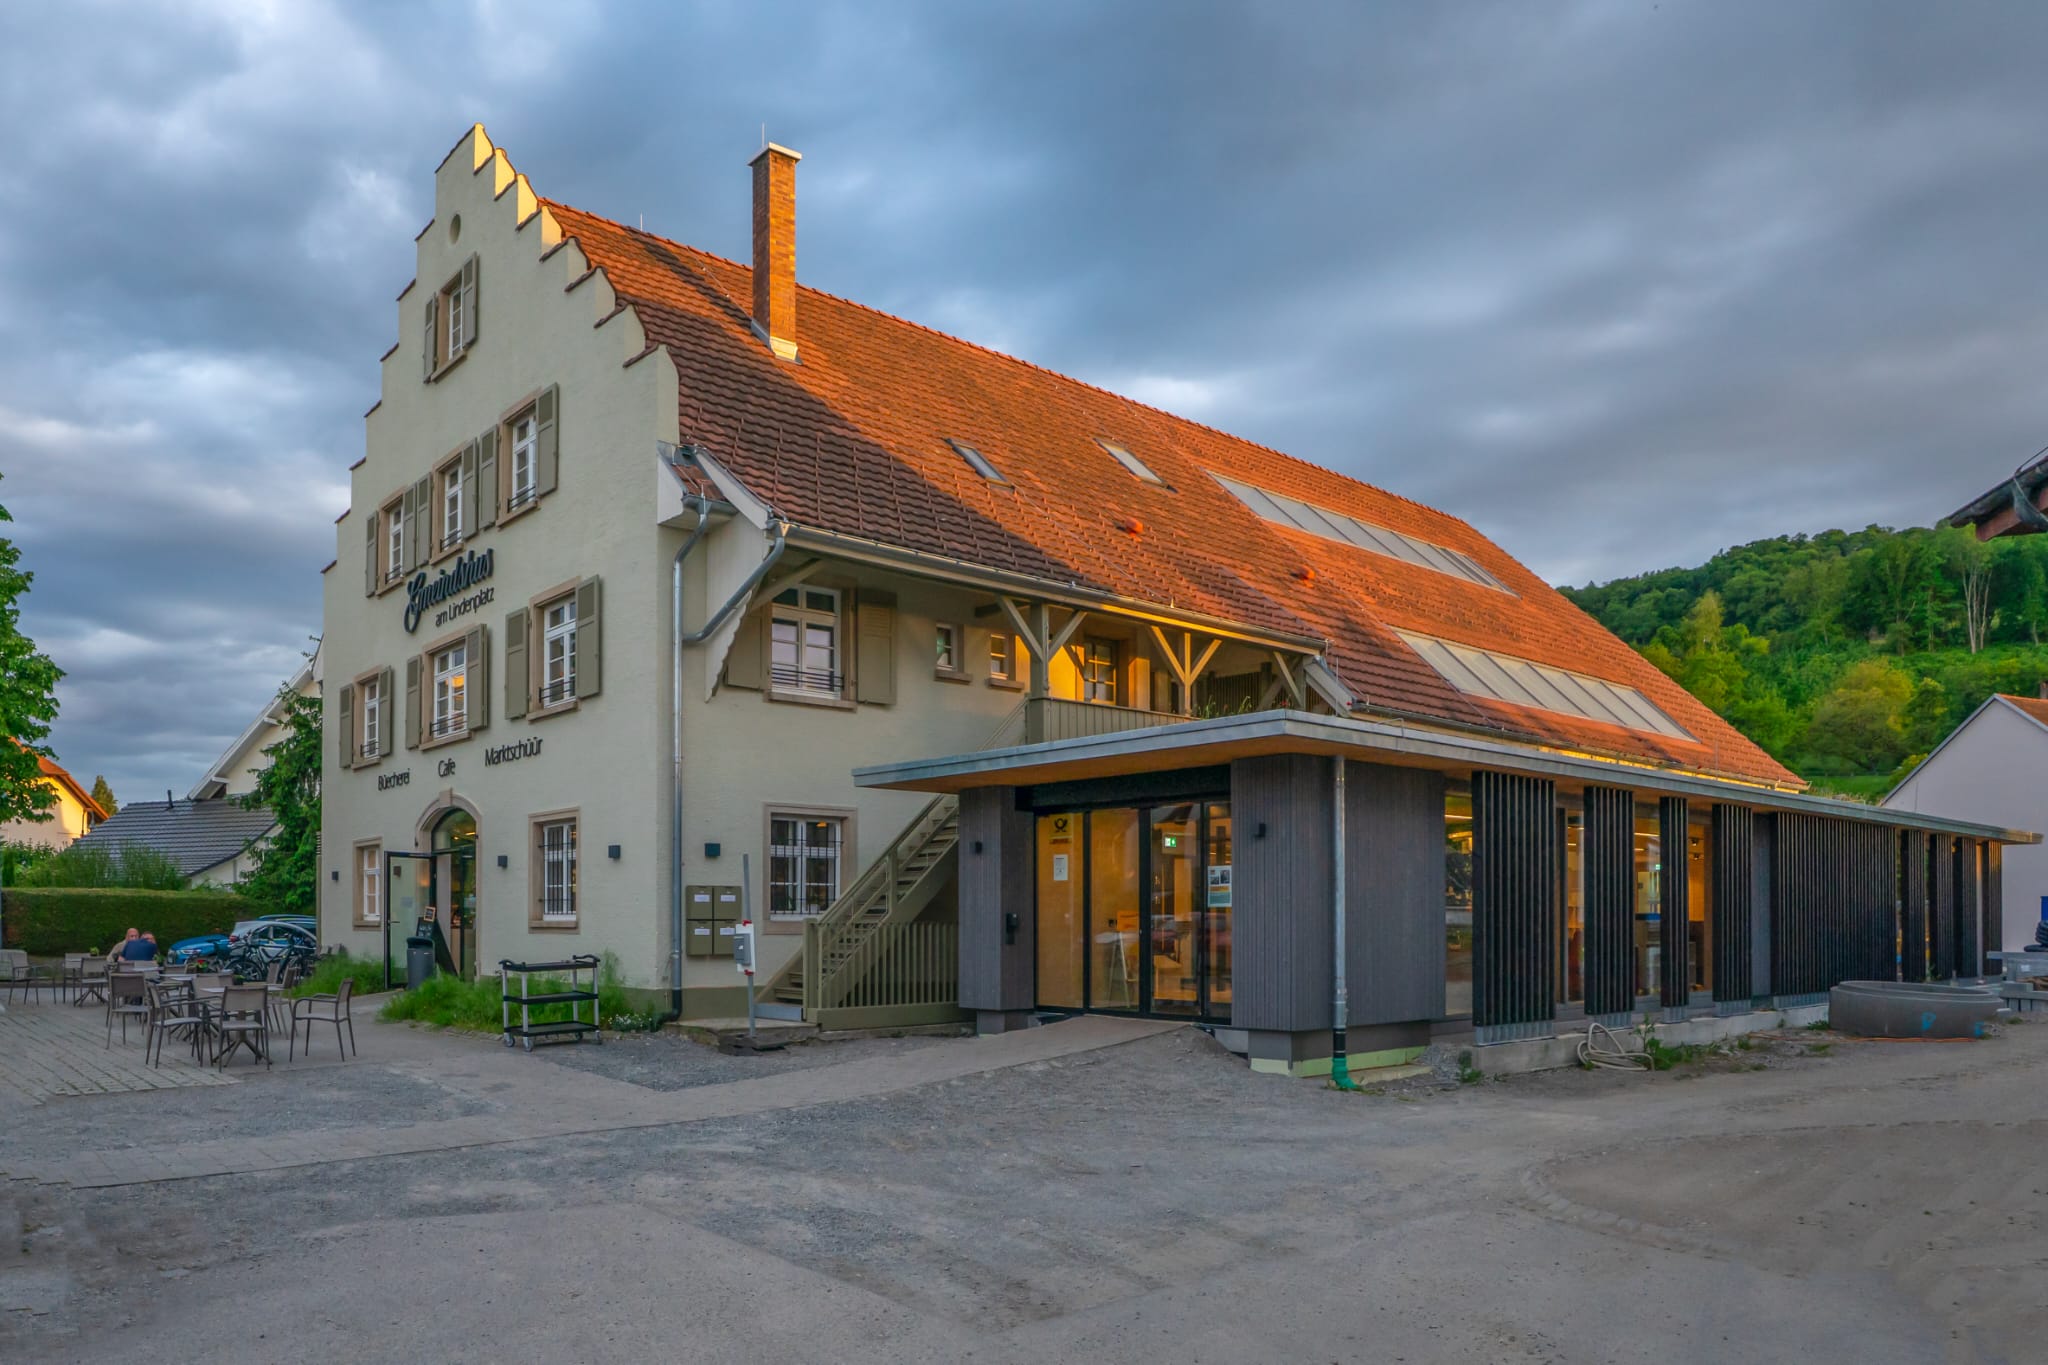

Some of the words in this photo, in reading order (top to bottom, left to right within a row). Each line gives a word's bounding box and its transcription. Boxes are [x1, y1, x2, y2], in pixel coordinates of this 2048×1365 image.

[435, 610, 448, 627] am
[448, 587, 495, 620] Lindenplatz
[485, 736, 543, 767] Marktschüür
